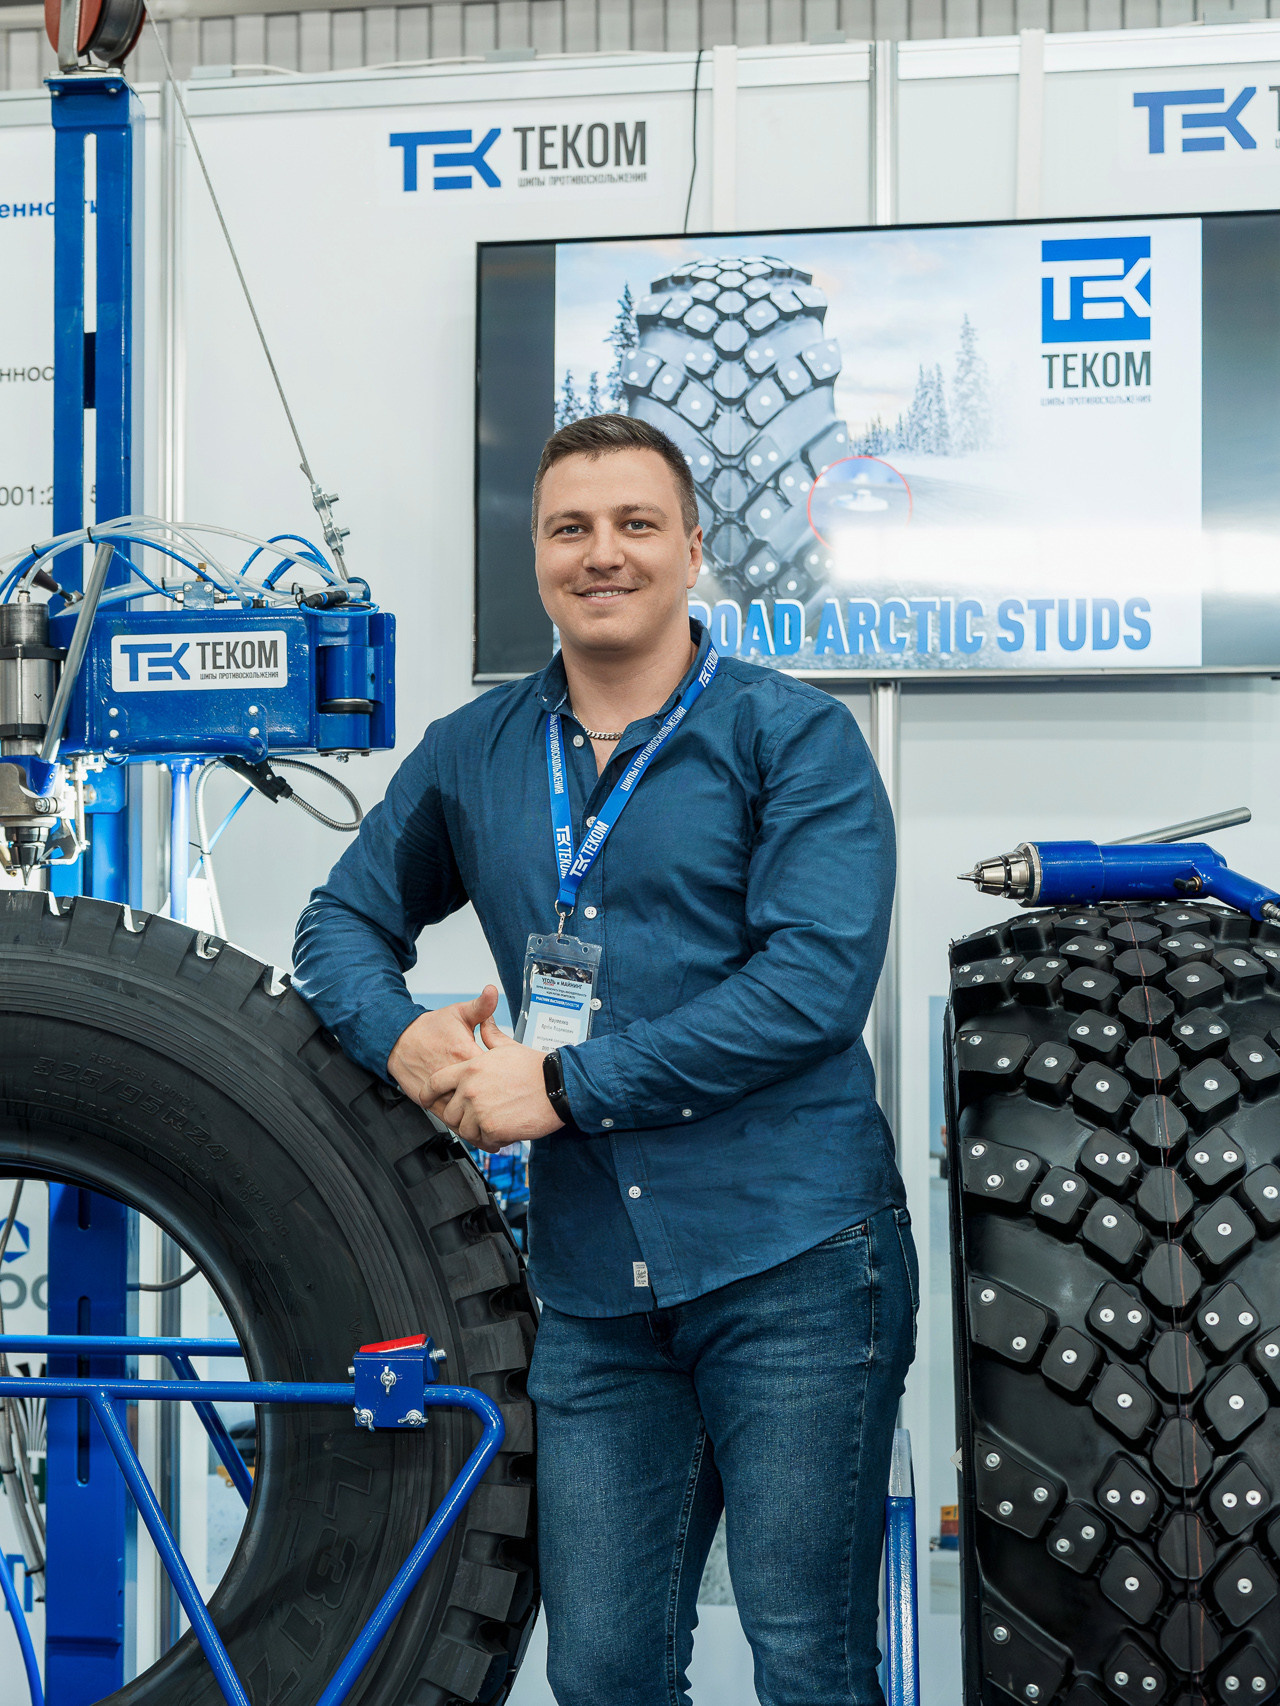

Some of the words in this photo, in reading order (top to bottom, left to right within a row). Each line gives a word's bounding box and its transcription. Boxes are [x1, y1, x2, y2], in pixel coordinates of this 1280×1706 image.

[513, 121, 646, 171] ТЕКОМ
[1042, 351, 1151, 388] ТЕКОМ
[814, 598, 985, 656] ARCTIC
[996, 596, 1152, 653] STUDS
[195, 640, 279, 671] ТЕКОМ
[219, 671, 279, 680] ПРОТИВОСКОЛЬЖЕНИЯ
[620, 765, 640, 792] ШИПЫ
[634, 706, 687, 770] ПРОТИВОСКОЛЬЖЕНИЯ
[581, 820, 610, 859] ТЕКОМ
[32, 1055, 230, 1162] 325/95R24
